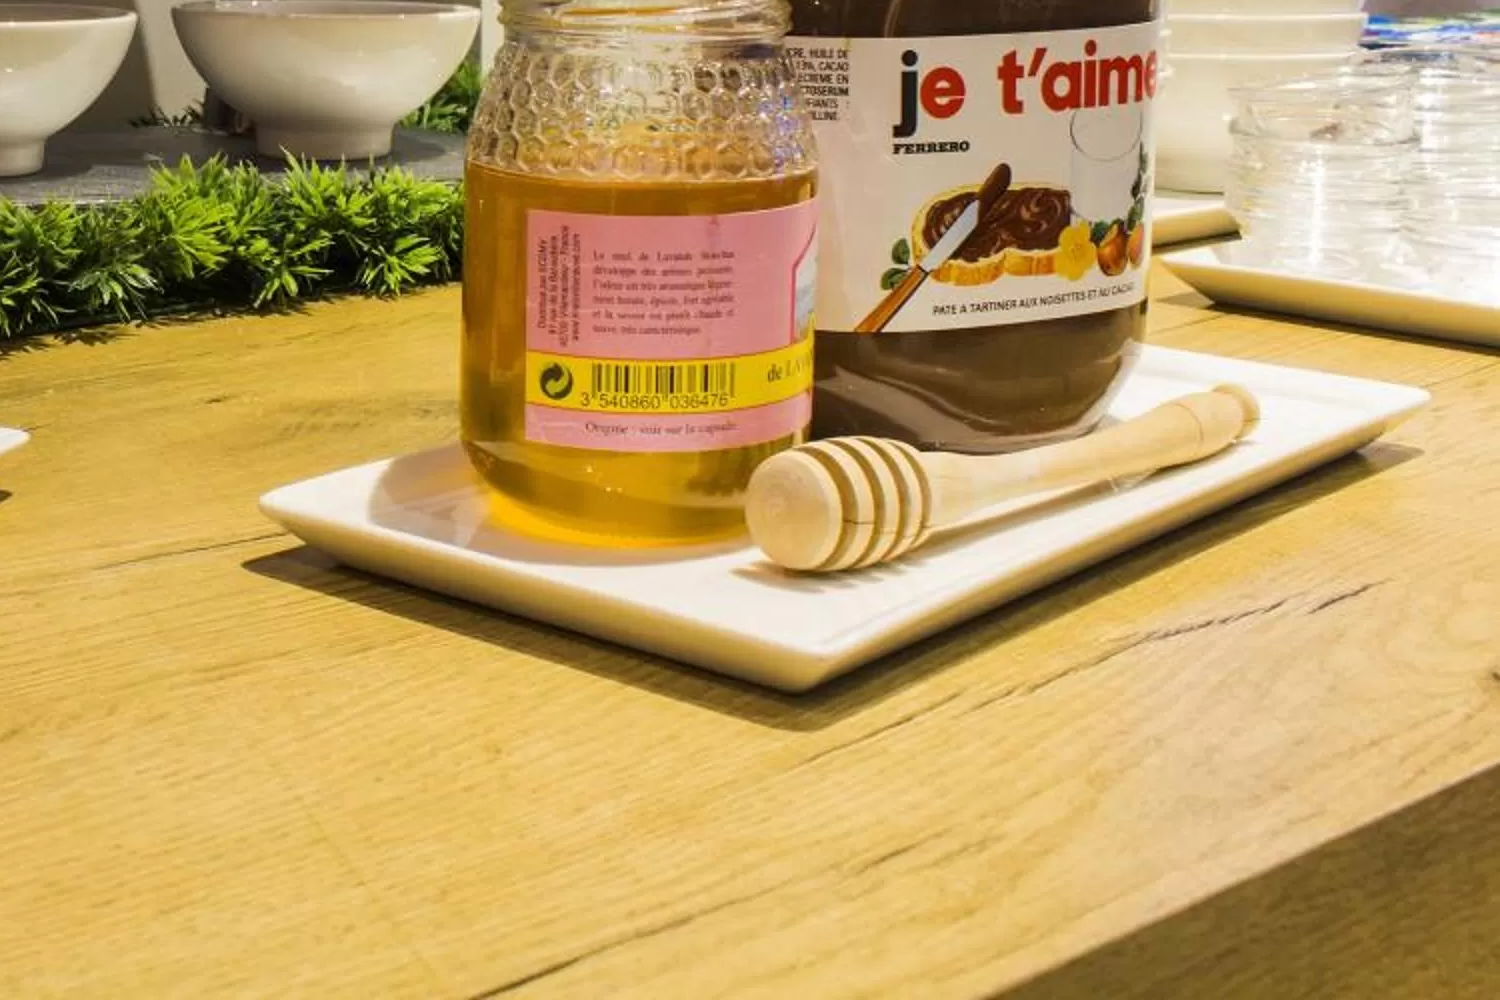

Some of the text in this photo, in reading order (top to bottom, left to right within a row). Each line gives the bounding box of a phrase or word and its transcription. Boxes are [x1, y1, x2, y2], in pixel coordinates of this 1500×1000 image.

[893, 49, 966, 138] je
[893, 140, 970, 155] FERRERO
[969, 300, 1017, 313] TARTINER
[1019, 298, 1038, 309] AUX
[1039, 289, 1085, 306] NOISETTES
[580, 391, 591, 407] 3
